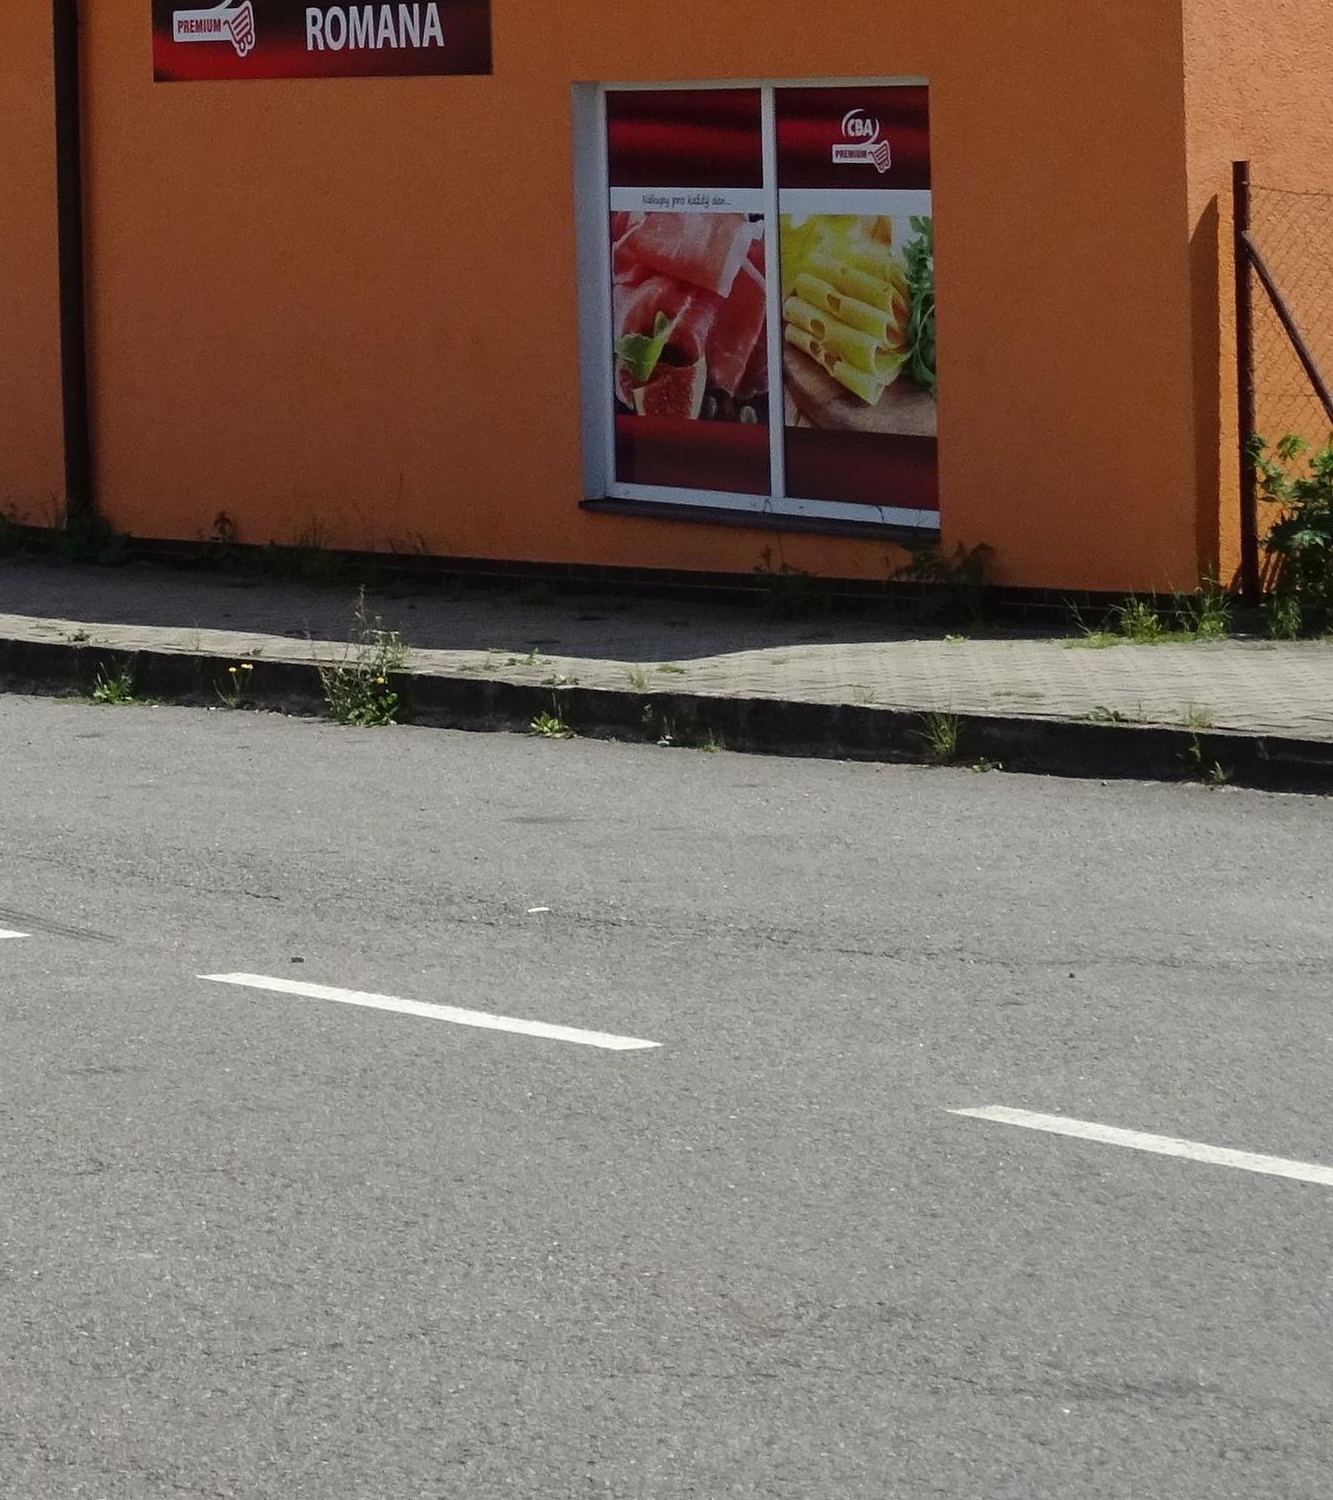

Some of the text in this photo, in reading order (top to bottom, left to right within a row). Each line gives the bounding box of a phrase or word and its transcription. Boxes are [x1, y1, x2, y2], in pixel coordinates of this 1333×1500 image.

[177, 19, 222, 33] PREMIUM
[306, 2, 444, 50] ROMANA
[847, 118, 873, 137] CBA
